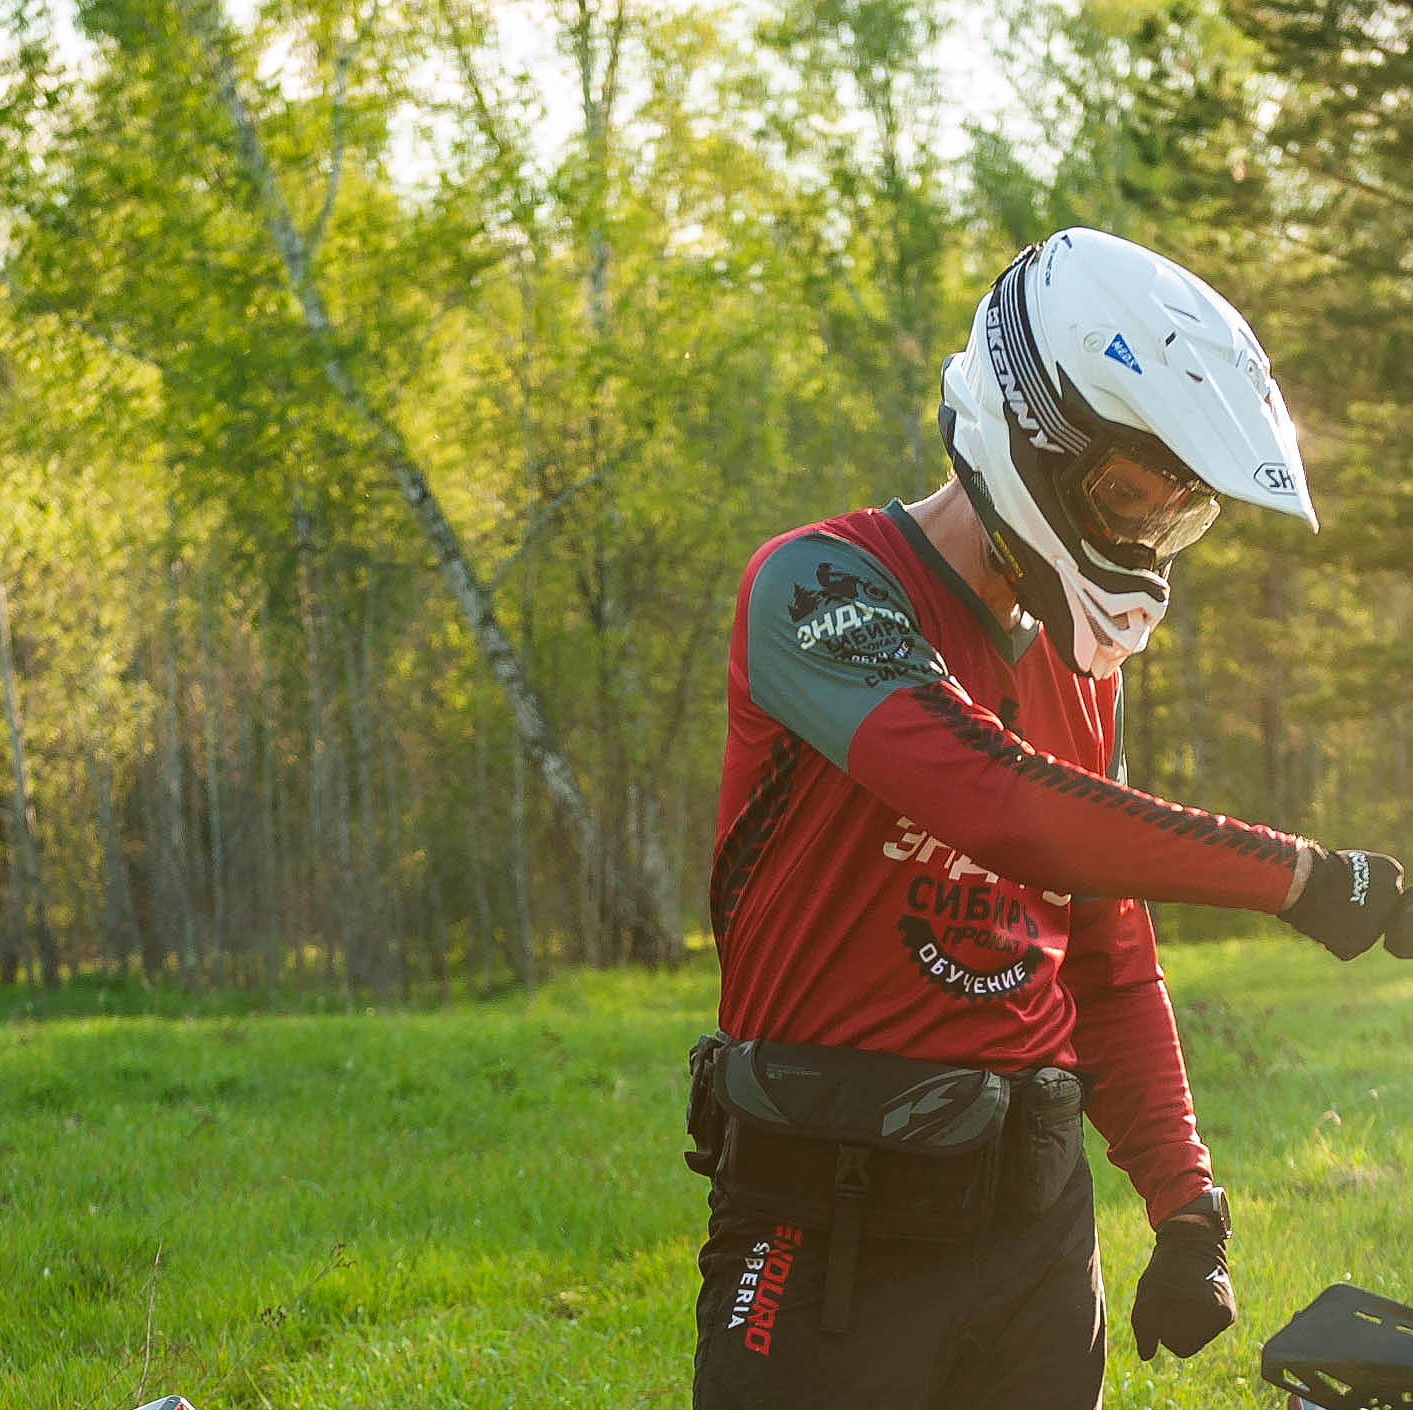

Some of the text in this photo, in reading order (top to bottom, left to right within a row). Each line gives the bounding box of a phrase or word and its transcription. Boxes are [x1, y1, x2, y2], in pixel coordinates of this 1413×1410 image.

[987, 324, 1065, 454] KENNY
[907, 874, 1040, 940] СИБИРЬ
[918, 942, 1027, 995] ОБУЧЕНИЕ
